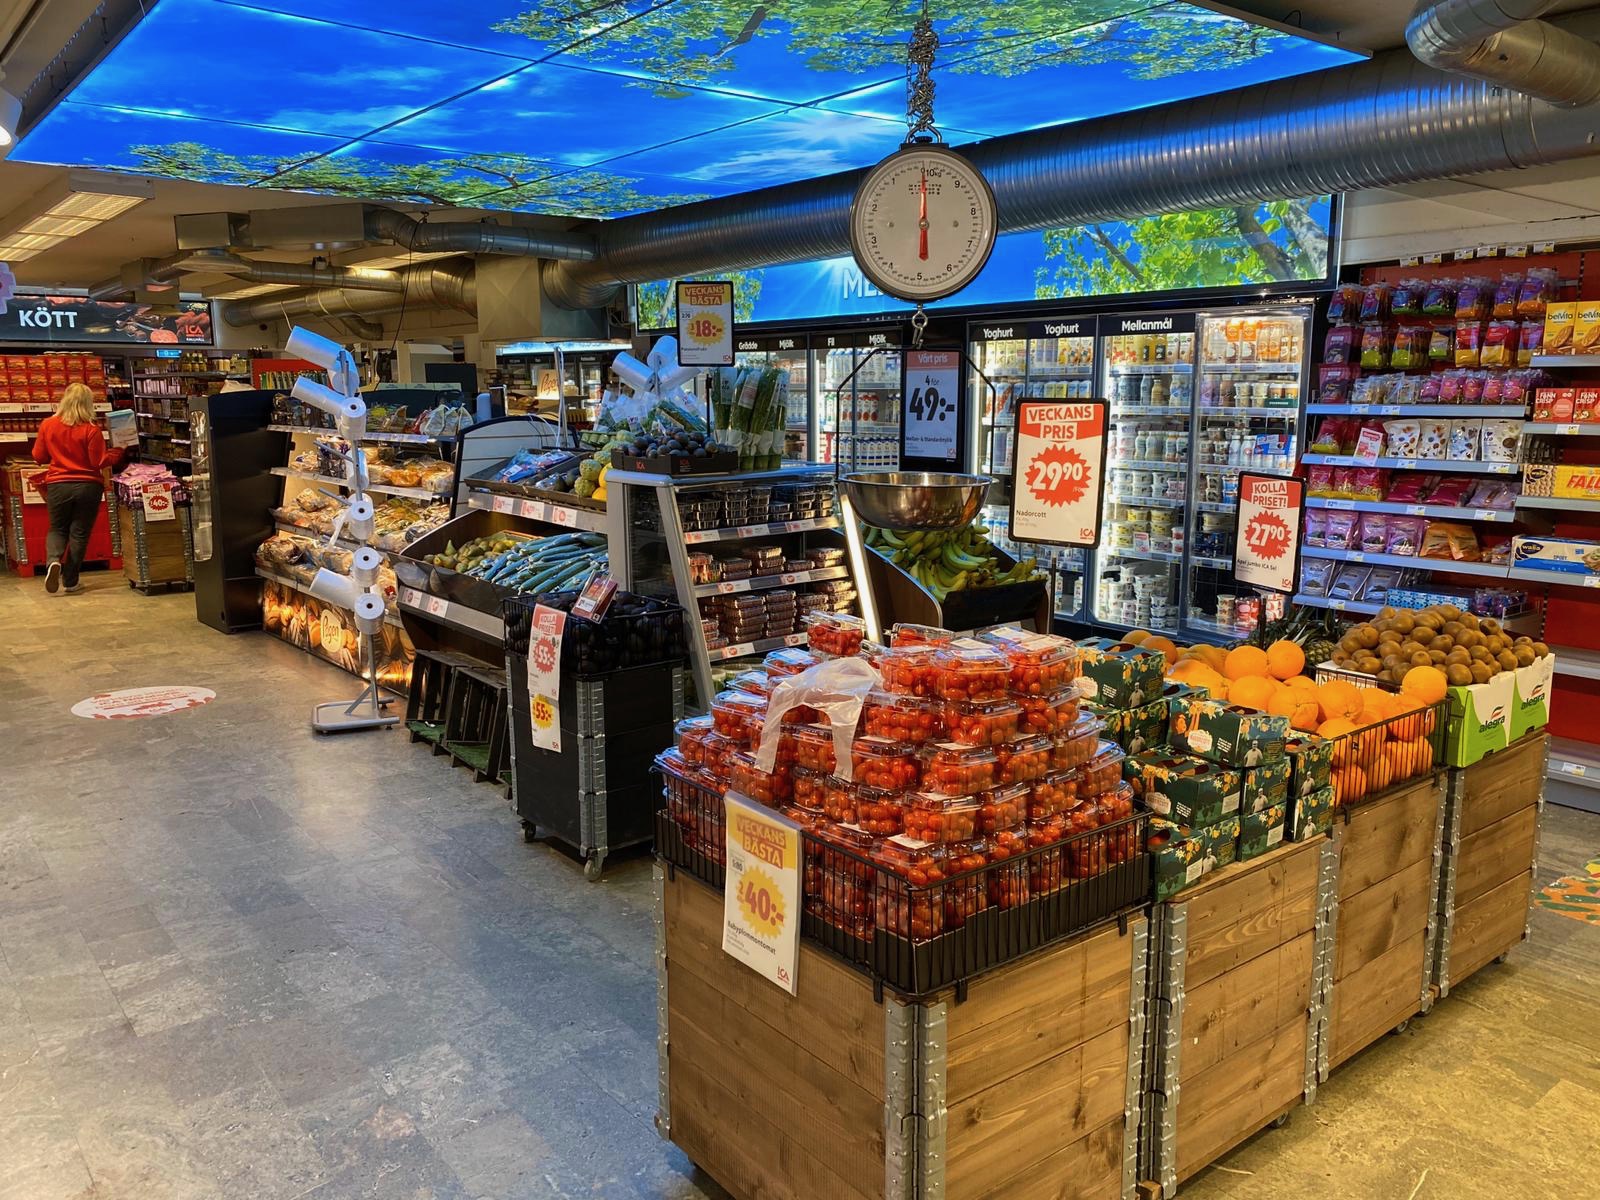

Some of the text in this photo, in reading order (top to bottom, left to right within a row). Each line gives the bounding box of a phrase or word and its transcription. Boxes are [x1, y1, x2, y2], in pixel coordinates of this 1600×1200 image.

[954, 180, 960, 189] 9
[871, 204, 877, 212] 2
[970, 207, 976, 216] 8
[871, 236, 877, 244] 3
[967, 240, 973, 248] 7
[888, 262, 893, 270] 4
[946, 264, 953, 272] 6
[916, 272, 923, 281] 5
[685, 285, 724, 296] VECKANS
[691, 295, 721, 305] BÄSTA
[18, 306, 78, 328] KÖTT
[1547, 311, 1574, 322] belVita
[185, 325, 203, 335] ICA
[1044, 322, 1080, 336] Yoghurt
[1121, 317, 1172, 332] Mellanmål
[983, 327, 1014, 340] Yoghurt
[738, 340, 758, 350] Grädde
[779, 339, 795, 350] Mjölk
[869, 334, 886, 345] Mjölk
[918, 354, 949, 365] Vårt pris
[925, 375, 939, 386] 4 för
[909, 387, 955, 421] 49:-
[1028, 406, 1092, 422] VECKANS
[1043, 424, 1075, 439] PRIS
[1254, 482, 1286, 494] KOLLA
[1252, 495, 1287, 508] PRISET!
[1016, 510, 1047, 518] Nadorcott
[1080, 527, 1095, 538] ICA
[1521, 693, 1545, 711] alegra
[1478, 715, 1506, 733] alegra
[736, 816, 786, 848] VECKANS
[743, 837, 783, 869] BÄSTA
[744, 881, 785, 927] 40:-
[727, 920, 776, 956] Babyplommontomat
[777, 965, 790, 982] ICA
